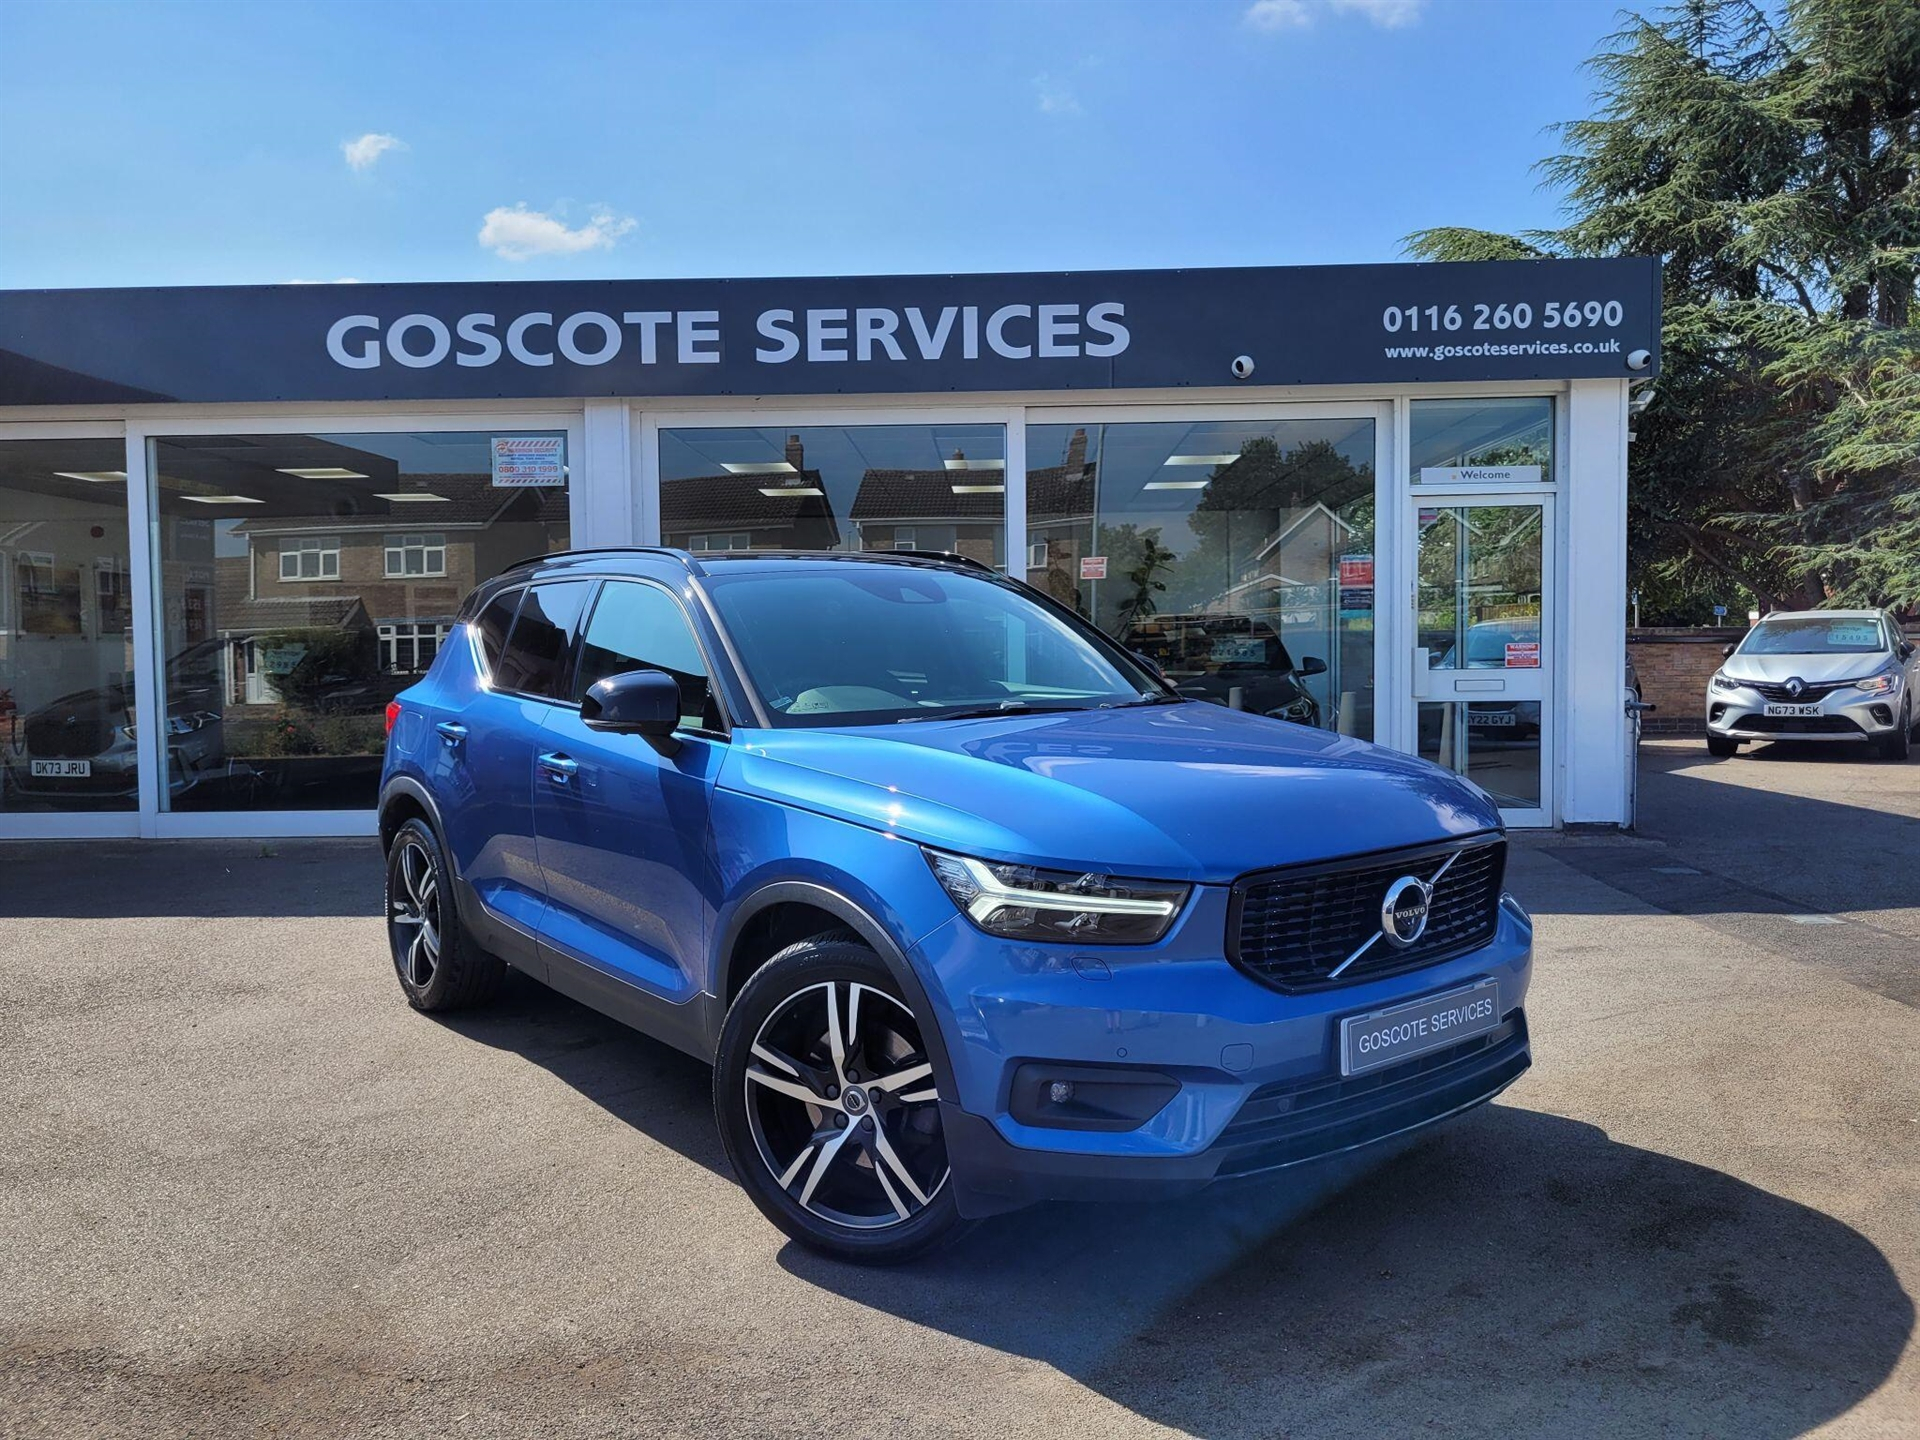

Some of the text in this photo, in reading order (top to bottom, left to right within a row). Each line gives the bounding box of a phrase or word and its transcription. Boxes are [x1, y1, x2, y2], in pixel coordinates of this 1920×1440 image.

[1383, 300, 1623, 332] 0116 260 5690
[326, 302, 1130, 369] GOSCOTE SERVICES
[1385, 338, 1621, 361] www.goscoteservices.co.uk
[498, 465, 558, 473] 0800 310 1999
[1460, 470, 1511, 479] Welcome
[1768, 705, 1820, 715] NG73 WSK
[1468, 715, 1511, 725] Y22 GYJ
[35, 762, 85, 775] DK73 JRU
[1394, 906, 1425, 919] VOLVO
[1358, 998, 1493, 1054] GOSCOTE SERVICES
